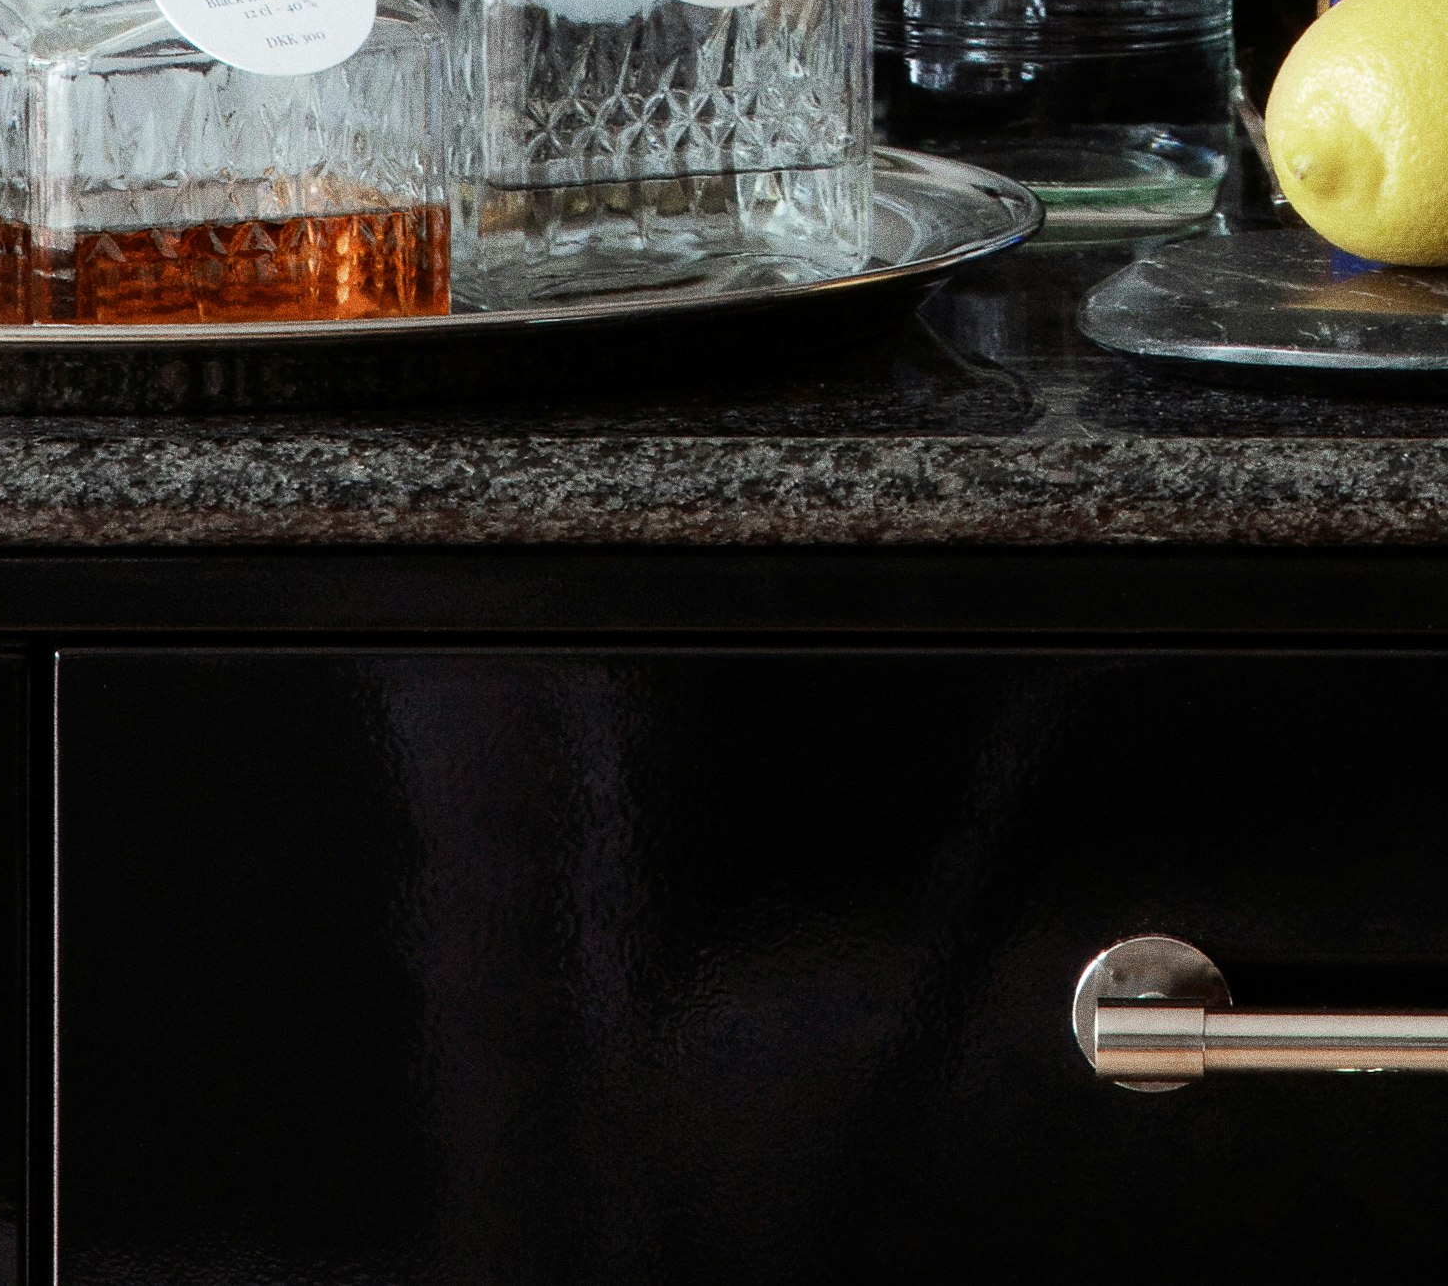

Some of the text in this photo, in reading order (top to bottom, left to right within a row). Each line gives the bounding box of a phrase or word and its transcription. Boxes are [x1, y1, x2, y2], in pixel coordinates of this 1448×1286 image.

[244, 9, 257, 19] 12
[259, 4, 272, 17] cl
[287, 2, 303, 13] 40
[265, 31, 327, 49] DKK 300
